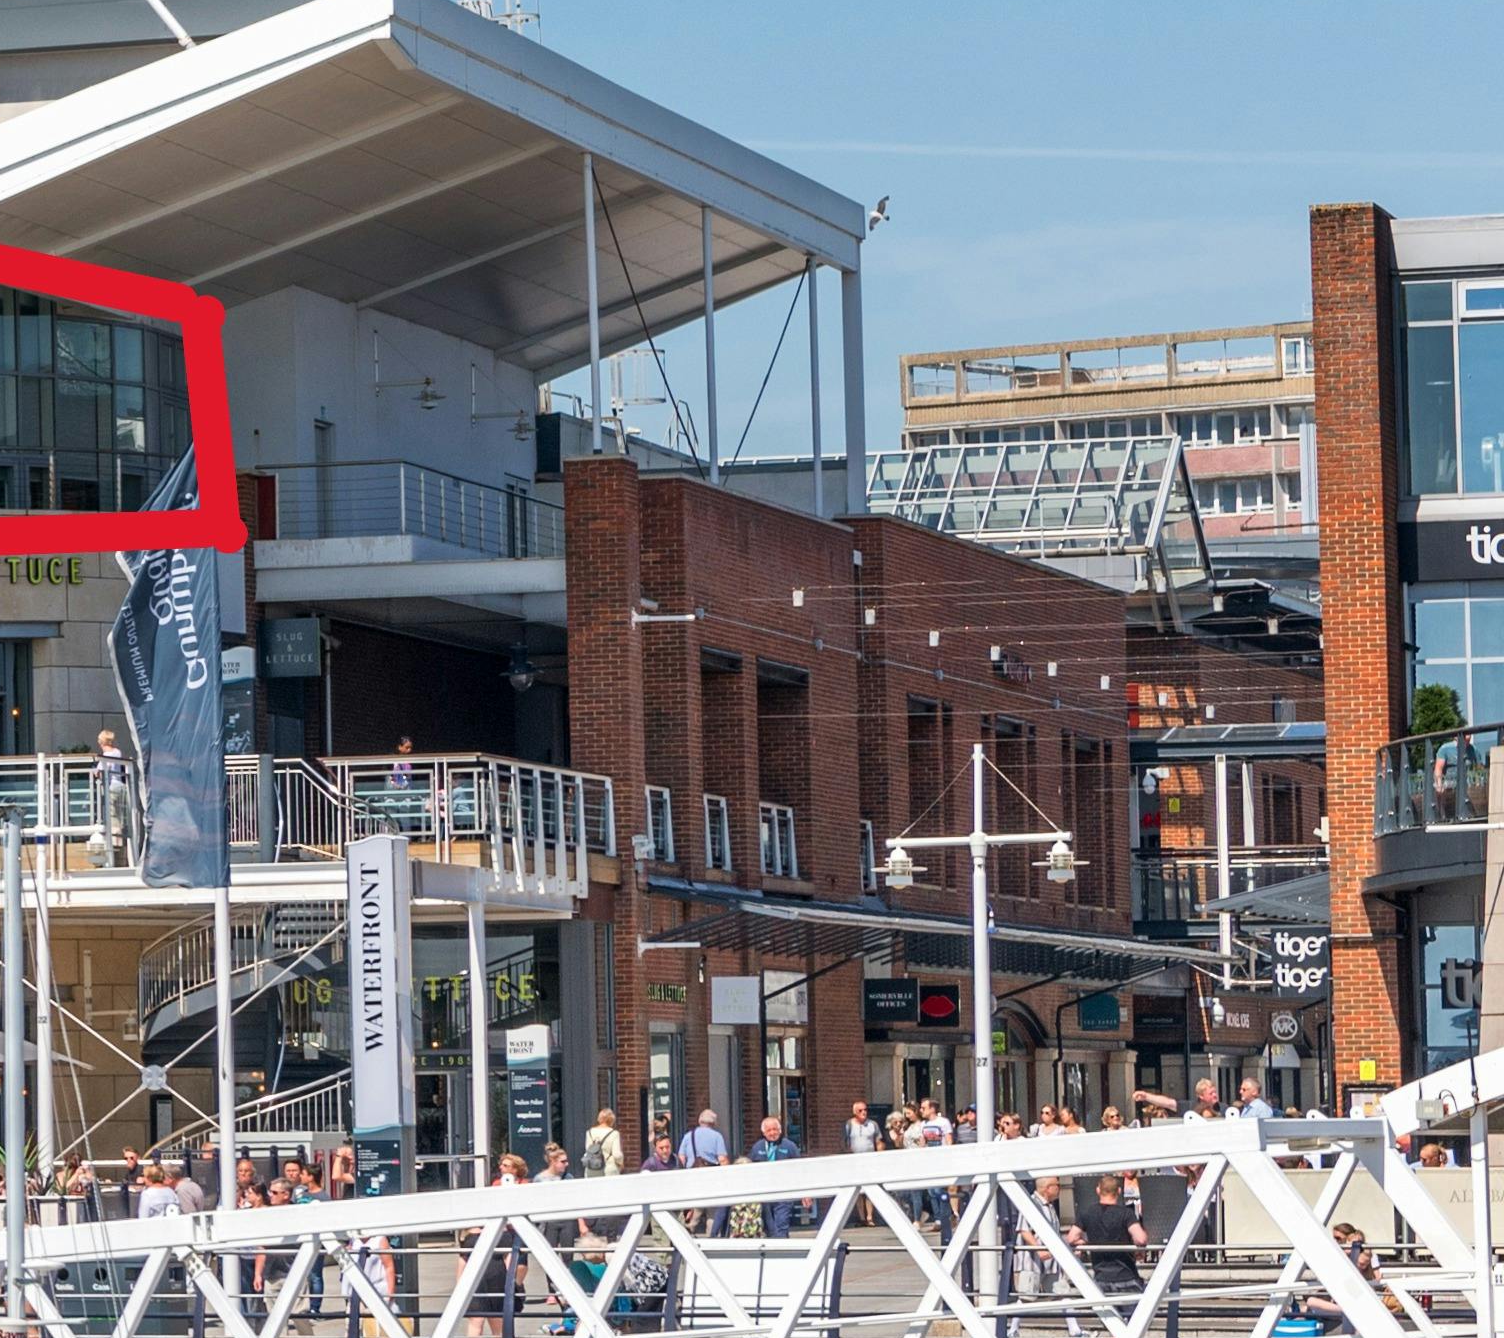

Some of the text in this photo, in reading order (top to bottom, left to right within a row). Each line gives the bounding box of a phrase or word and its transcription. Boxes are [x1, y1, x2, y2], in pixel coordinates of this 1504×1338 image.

[276, 632, 303, 641] SLUG
[266, 654, 314, 664] LETTUCE
[1274, 932, 1327, 962] tiger
[360, 862, 384, 1052] WATERFRONT
[1275, 963, 1327, 993] tiger
[869, 992, 913, 1000] SOMERVILLE
[876, 1000, 907, 1008] OFFICES
